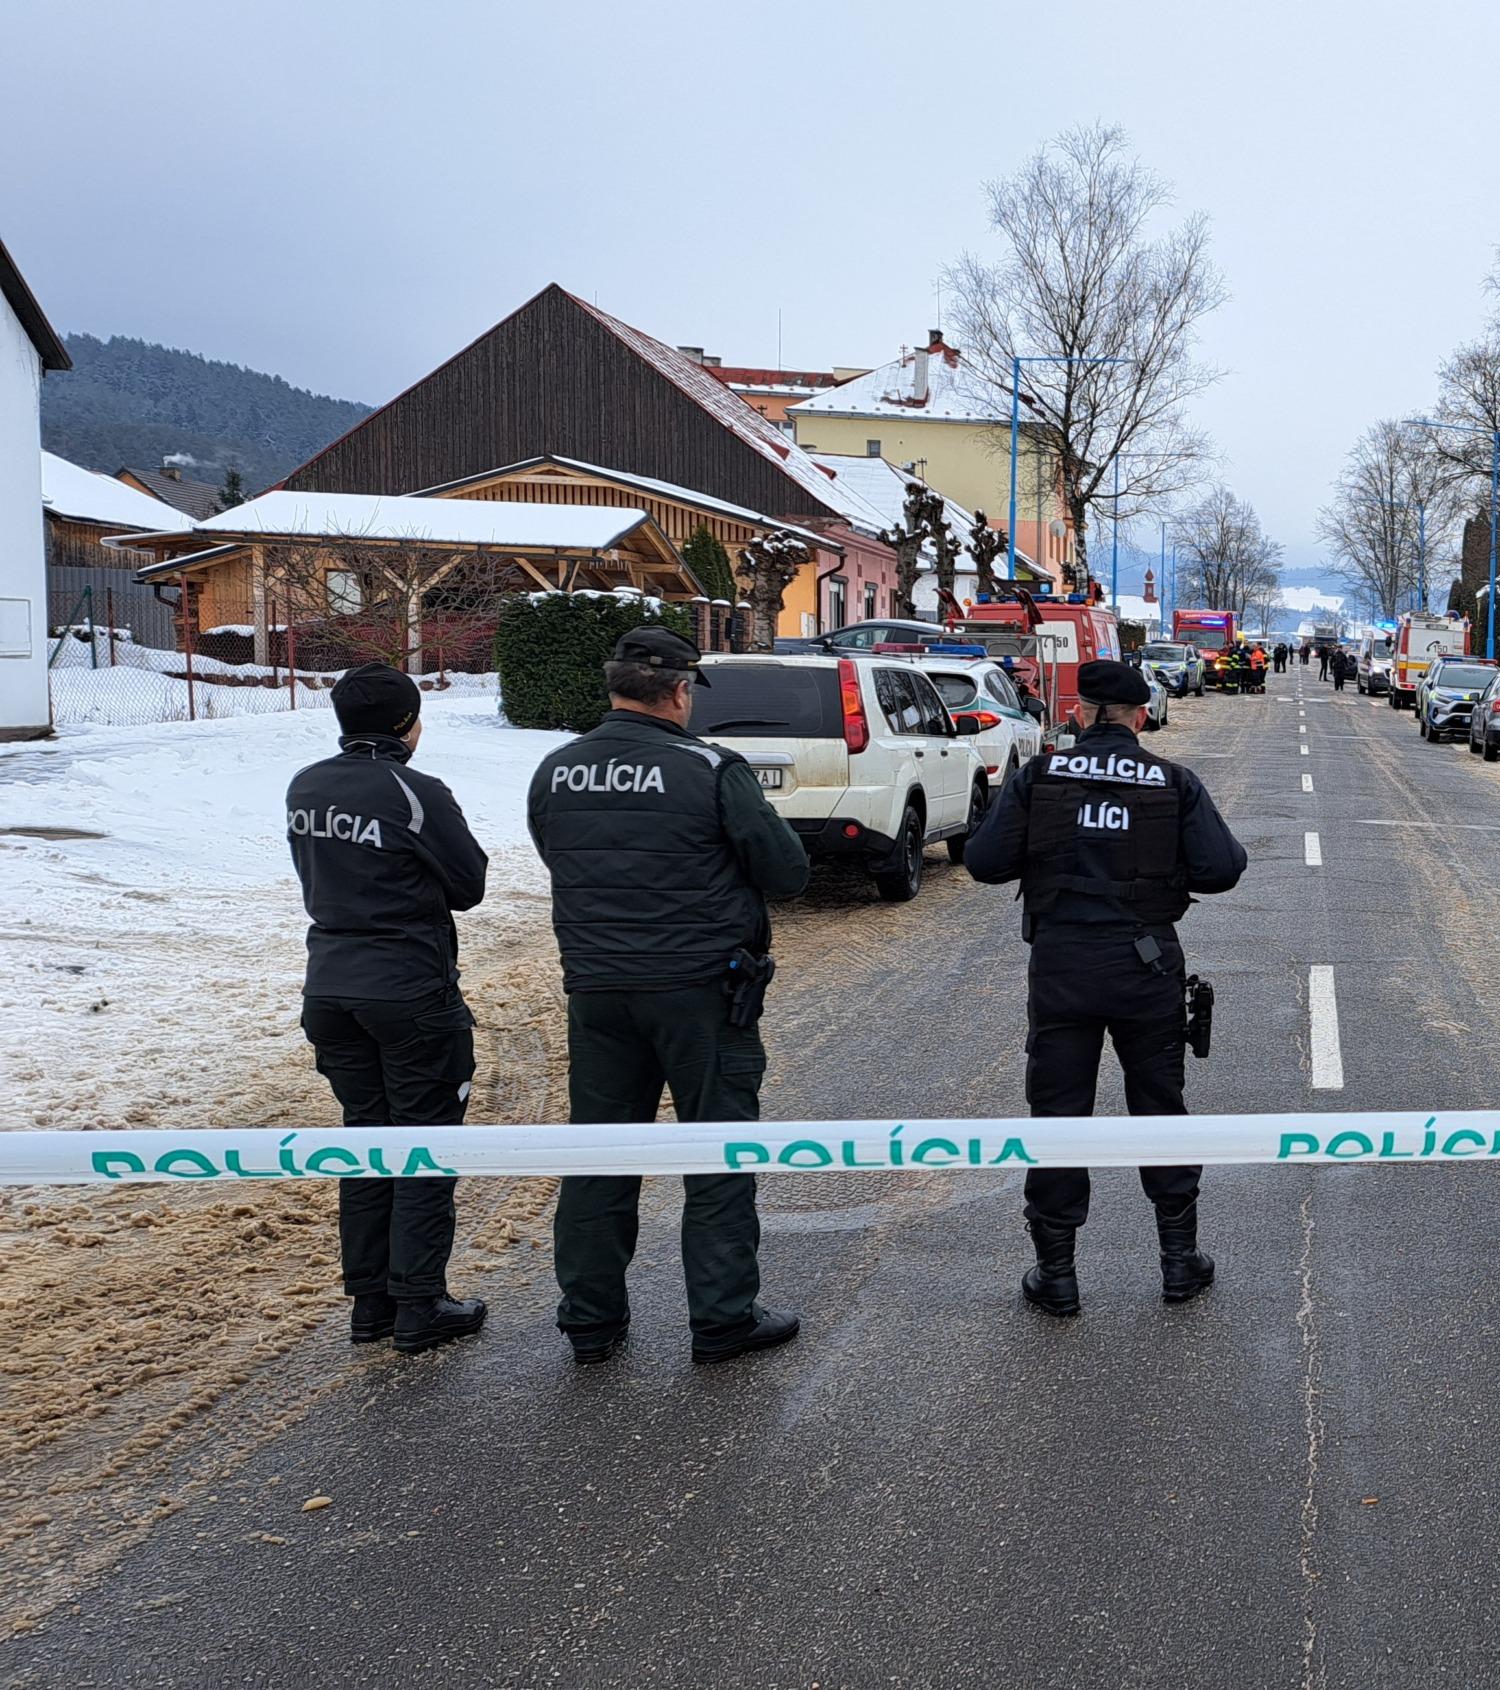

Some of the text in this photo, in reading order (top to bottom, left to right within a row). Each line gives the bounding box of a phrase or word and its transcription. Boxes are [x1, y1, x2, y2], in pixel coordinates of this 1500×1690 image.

[1434, 645, 1448, 654] 150
[551, 758, 665, 793] POLÍCIA
[1049, 754, 1166, 781] POLÍCIA
[91, 1132, 458, 1179] POLÍCIA
[724, 1124, 1039, 1170] POLÍCIA
